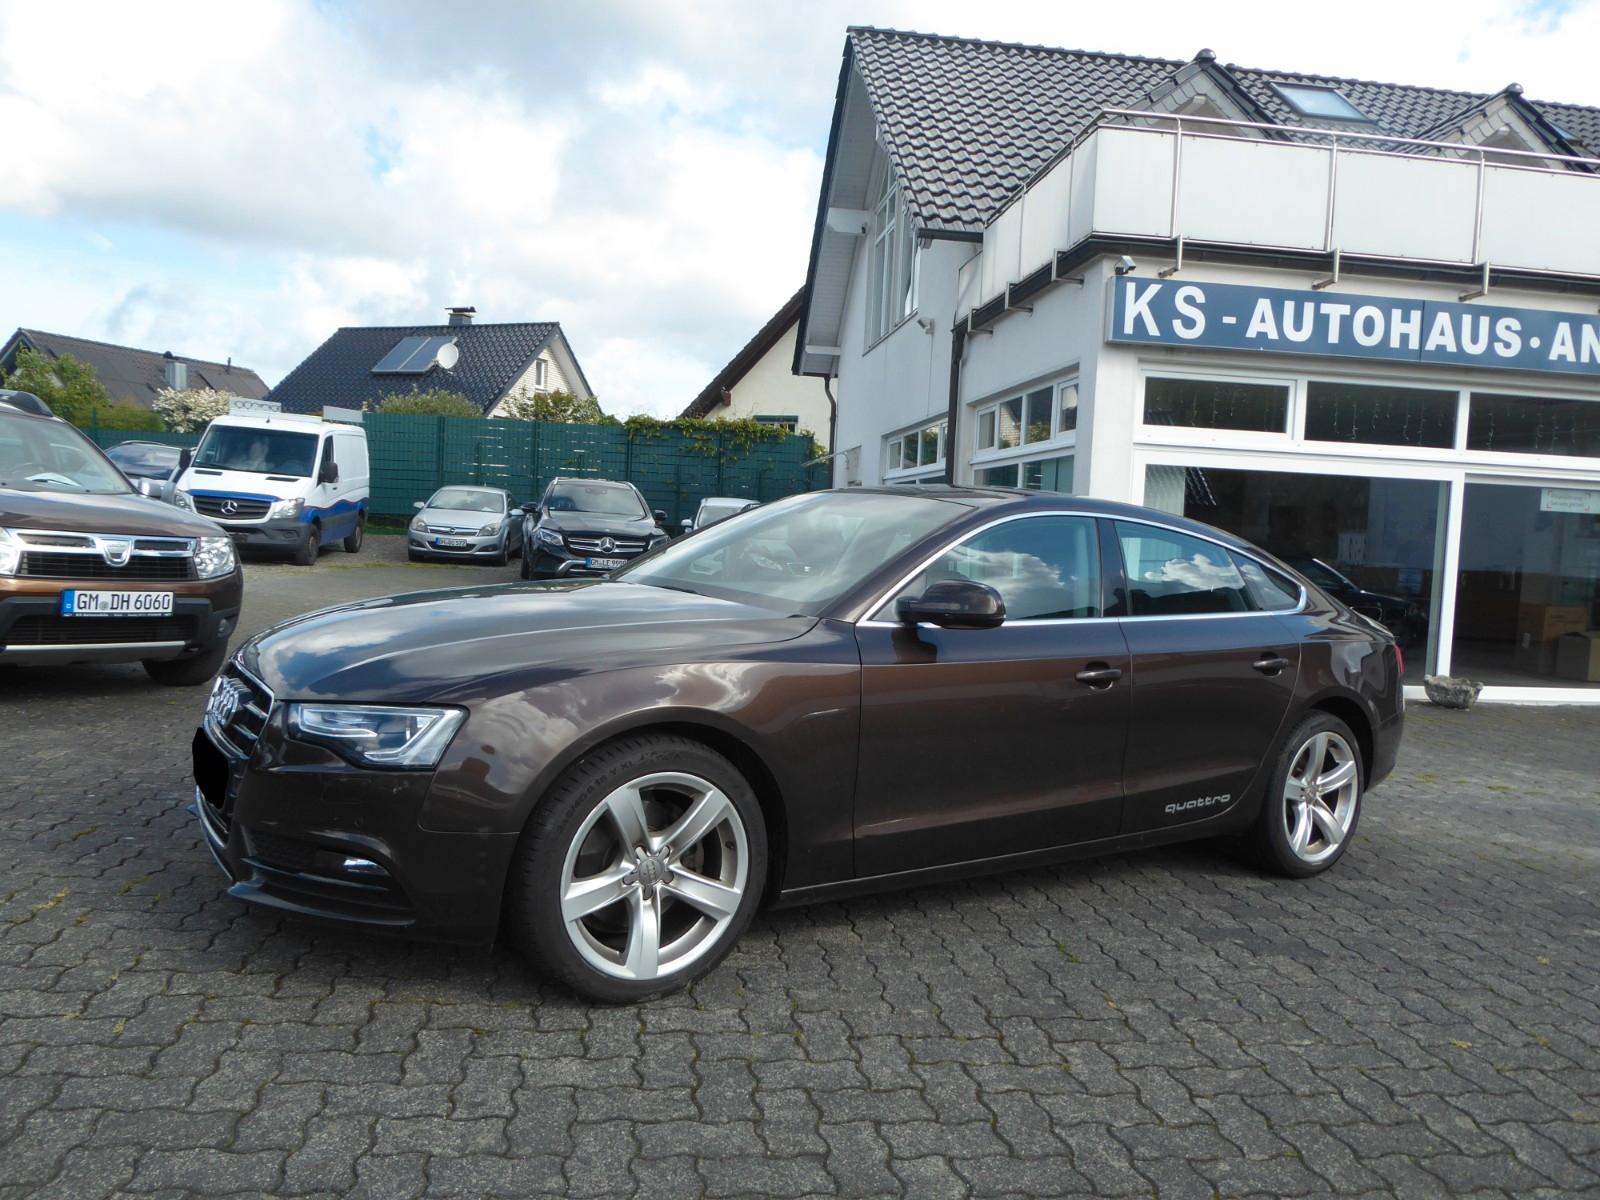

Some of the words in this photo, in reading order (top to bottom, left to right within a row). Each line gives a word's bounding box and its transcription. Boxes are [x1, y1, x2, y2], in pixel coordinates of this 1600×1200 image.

[1245, 298, 1522, 359] AUTOHAUS
[77, 593, 99, 610] GM
[110, 594, 131, 610] DH
[134, 594, 171, 610] 6060
[1165, 794, 1231, 814] quattro
